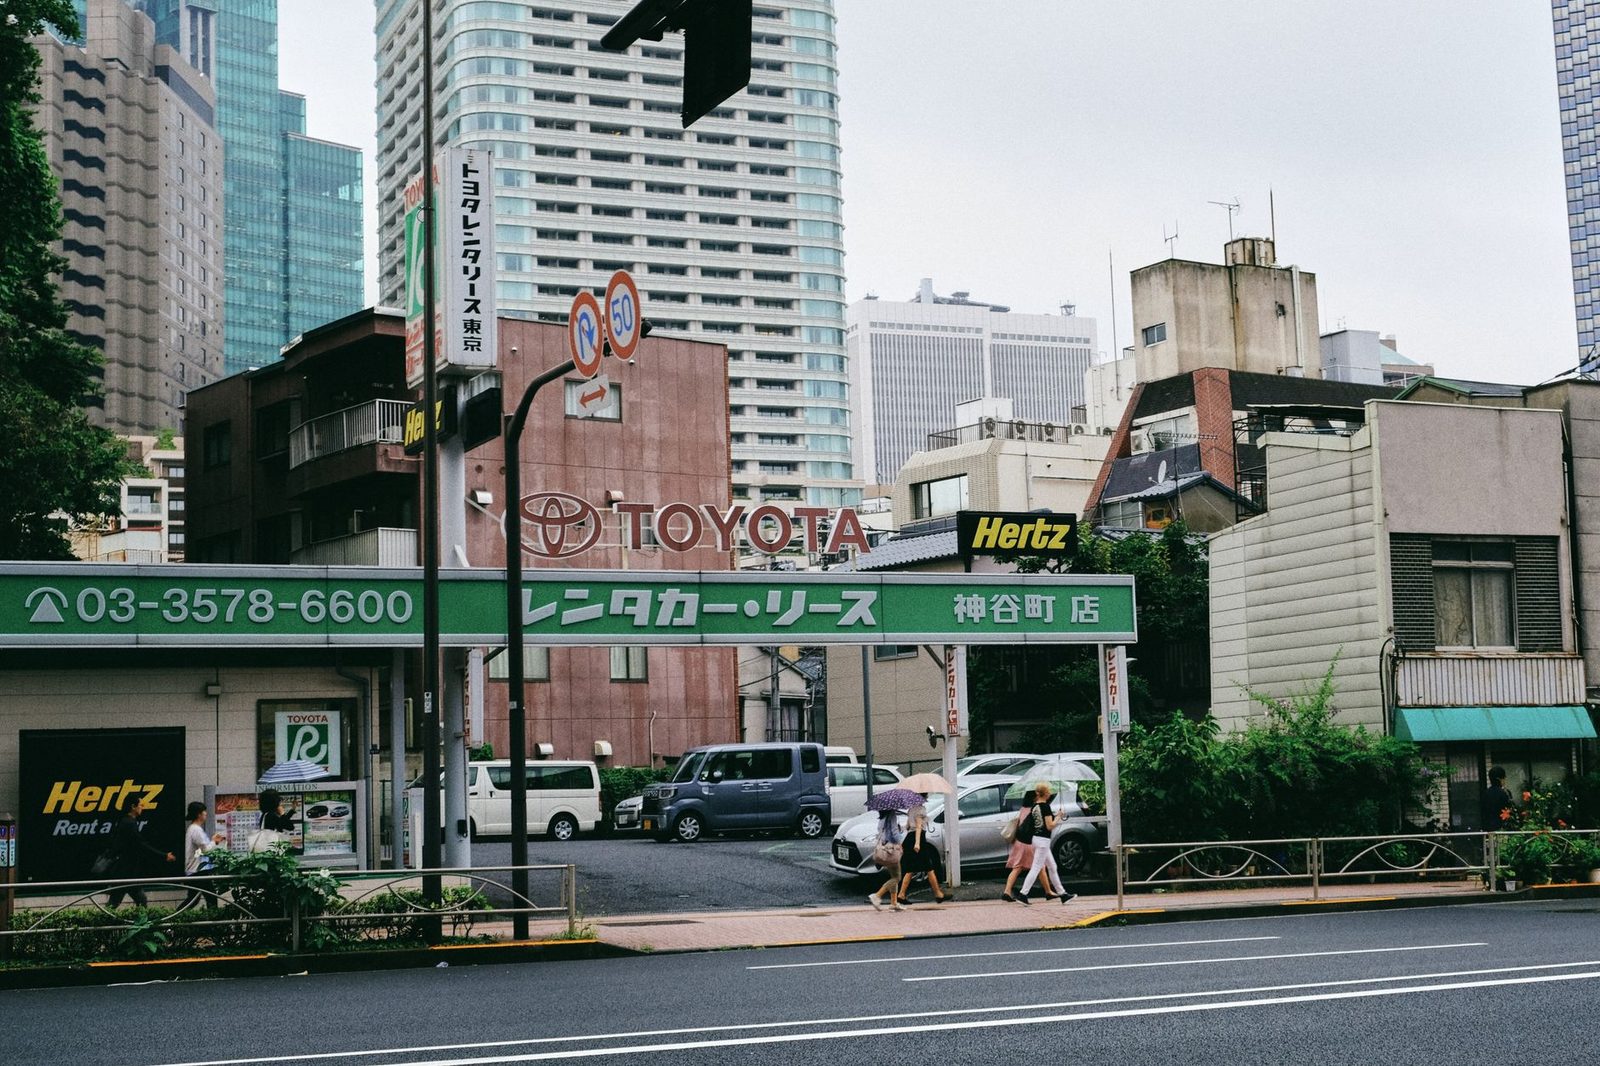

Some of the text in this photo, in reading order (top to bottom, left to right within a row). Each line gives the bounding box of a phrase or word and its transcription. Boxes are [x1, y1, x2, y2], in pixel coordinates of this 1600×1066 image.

[611, 294, 633, 337] 50
[612, 502, 871, 554] TOYOTA
[971, 517, 1071, 549] Hertz
[76, 587, 413, 624] 03-3578-6600
[953, 594, 1100, 623] 神谷町 店
[1108, 651, 1117, 705] レンタカー
[287, 715, 329, 723] TOYOTA
[42, 779, 165, 814] Hertz
[52, 819, 99, 836] Rent
[101, 822, 112, 834] a
